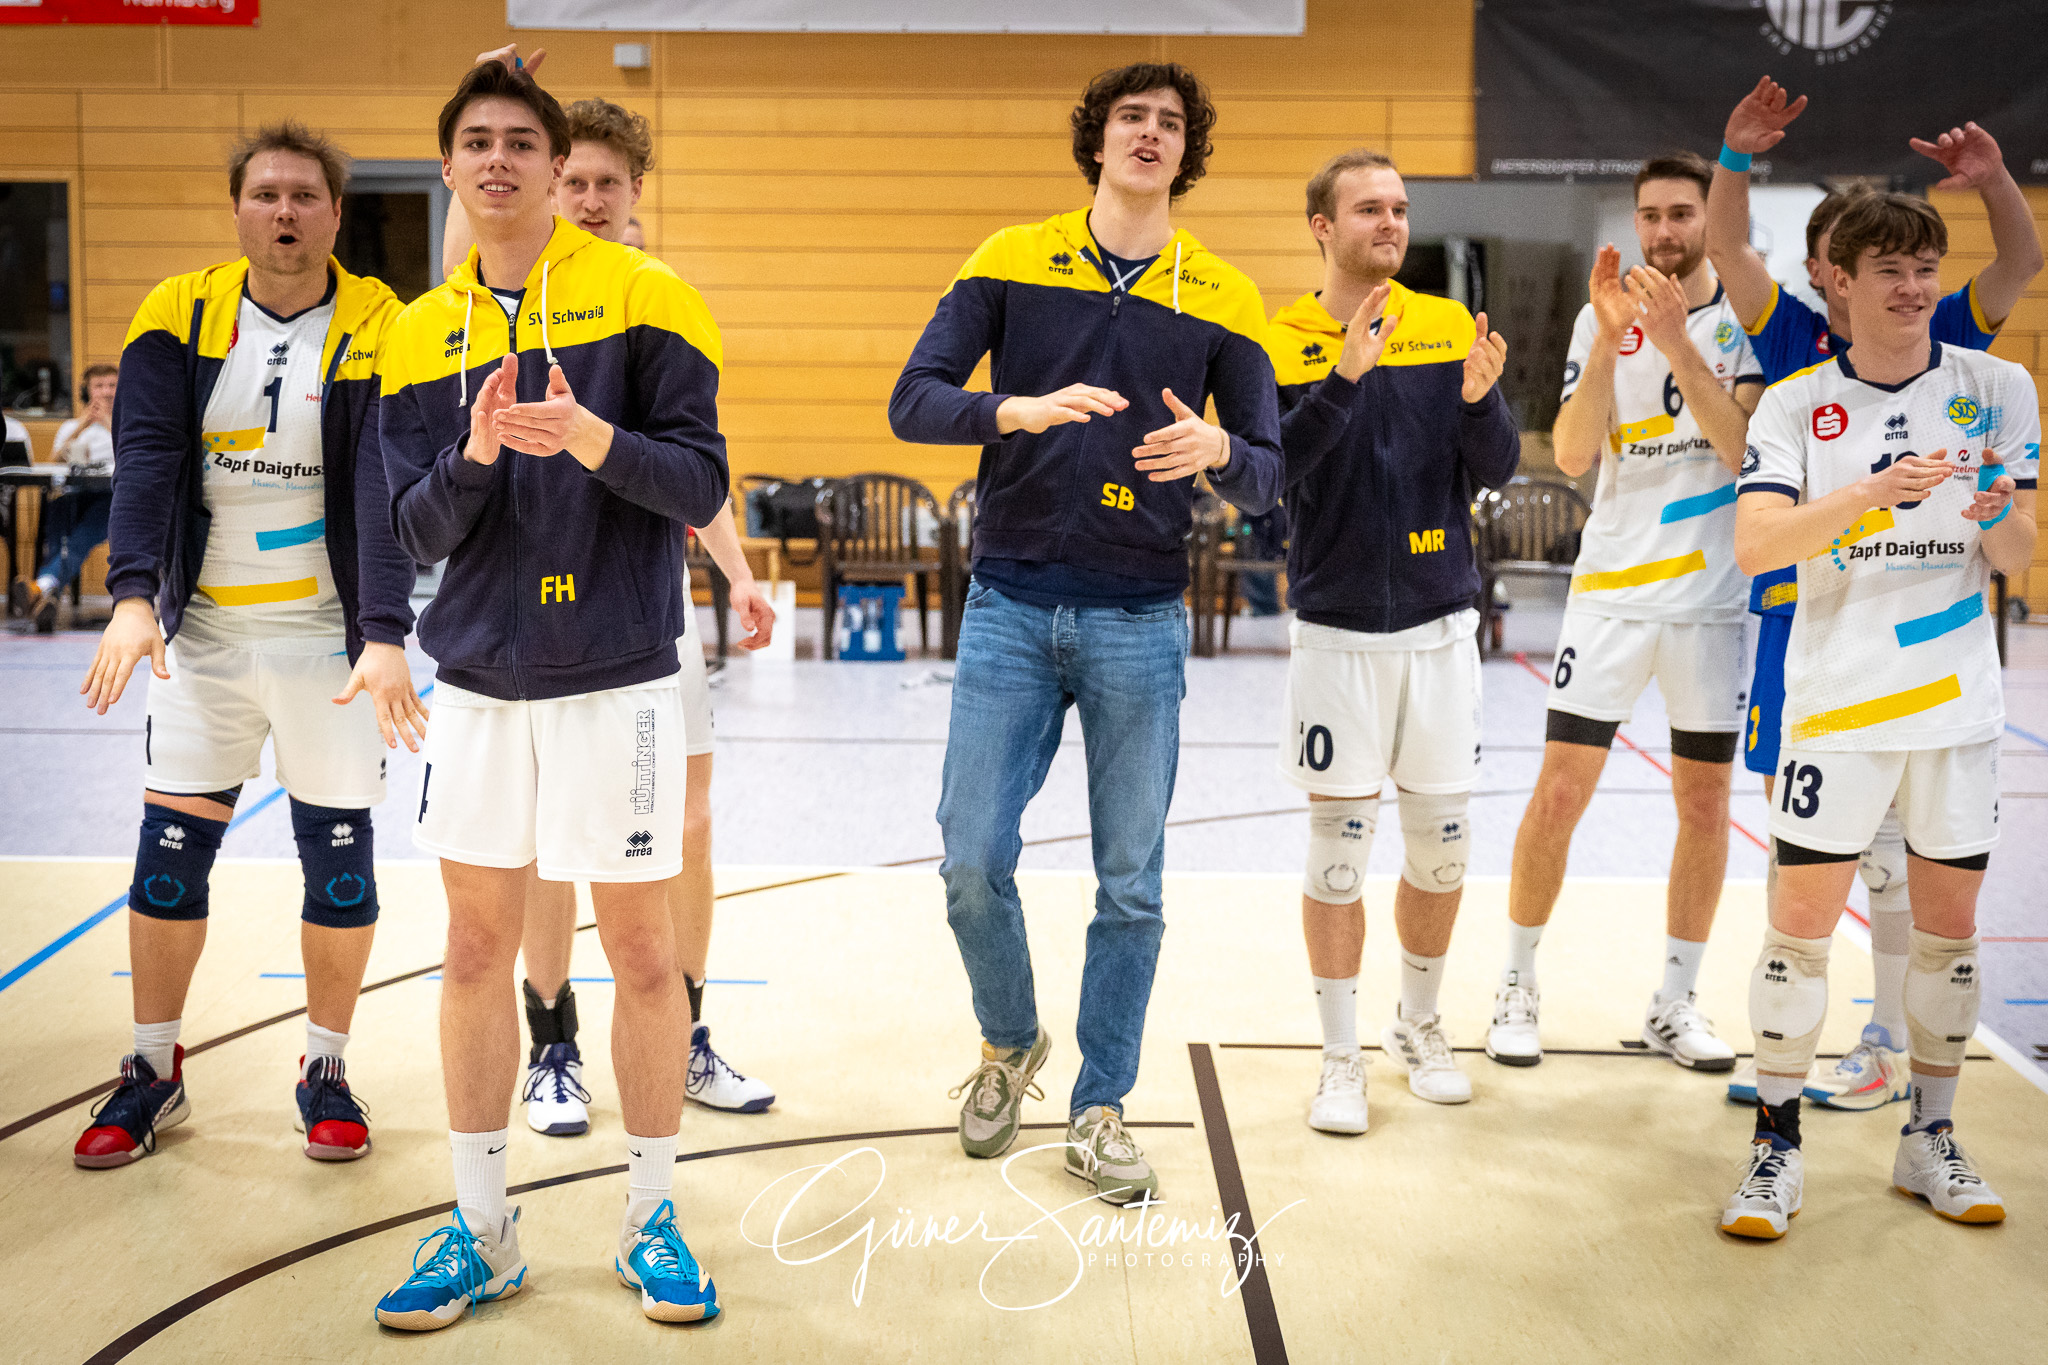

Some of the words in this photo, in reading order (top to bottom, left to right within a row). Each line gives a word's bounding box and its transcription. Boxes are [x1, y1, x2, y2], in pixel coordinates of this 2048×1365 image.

[552, 305, 604, 325] Schwaig
[1390, 342, 1404, 354] SV
[1409, 339, 1453, 352] Schwaig
[263, 376, 283, 433] 1
[1628, 442, 1665, 459] Zapf
[213, 452, 251, 474] Zapf
[1100, 482, 1135, 512] SB
[1408, 528, 1446, 555] MR
[1848, 541, 1882, 561] Zapf
[1885, 539, 1965, 559] Daigfuss
[540, 573, 576, 605] FH
[1555, 647, 1577, 690] 6
[1781, 759, 1824, 819] 13
[159, 837, 184, 851] errea
[331, 836, 355, 848] errea
[625, 846, 653, 858] errea
